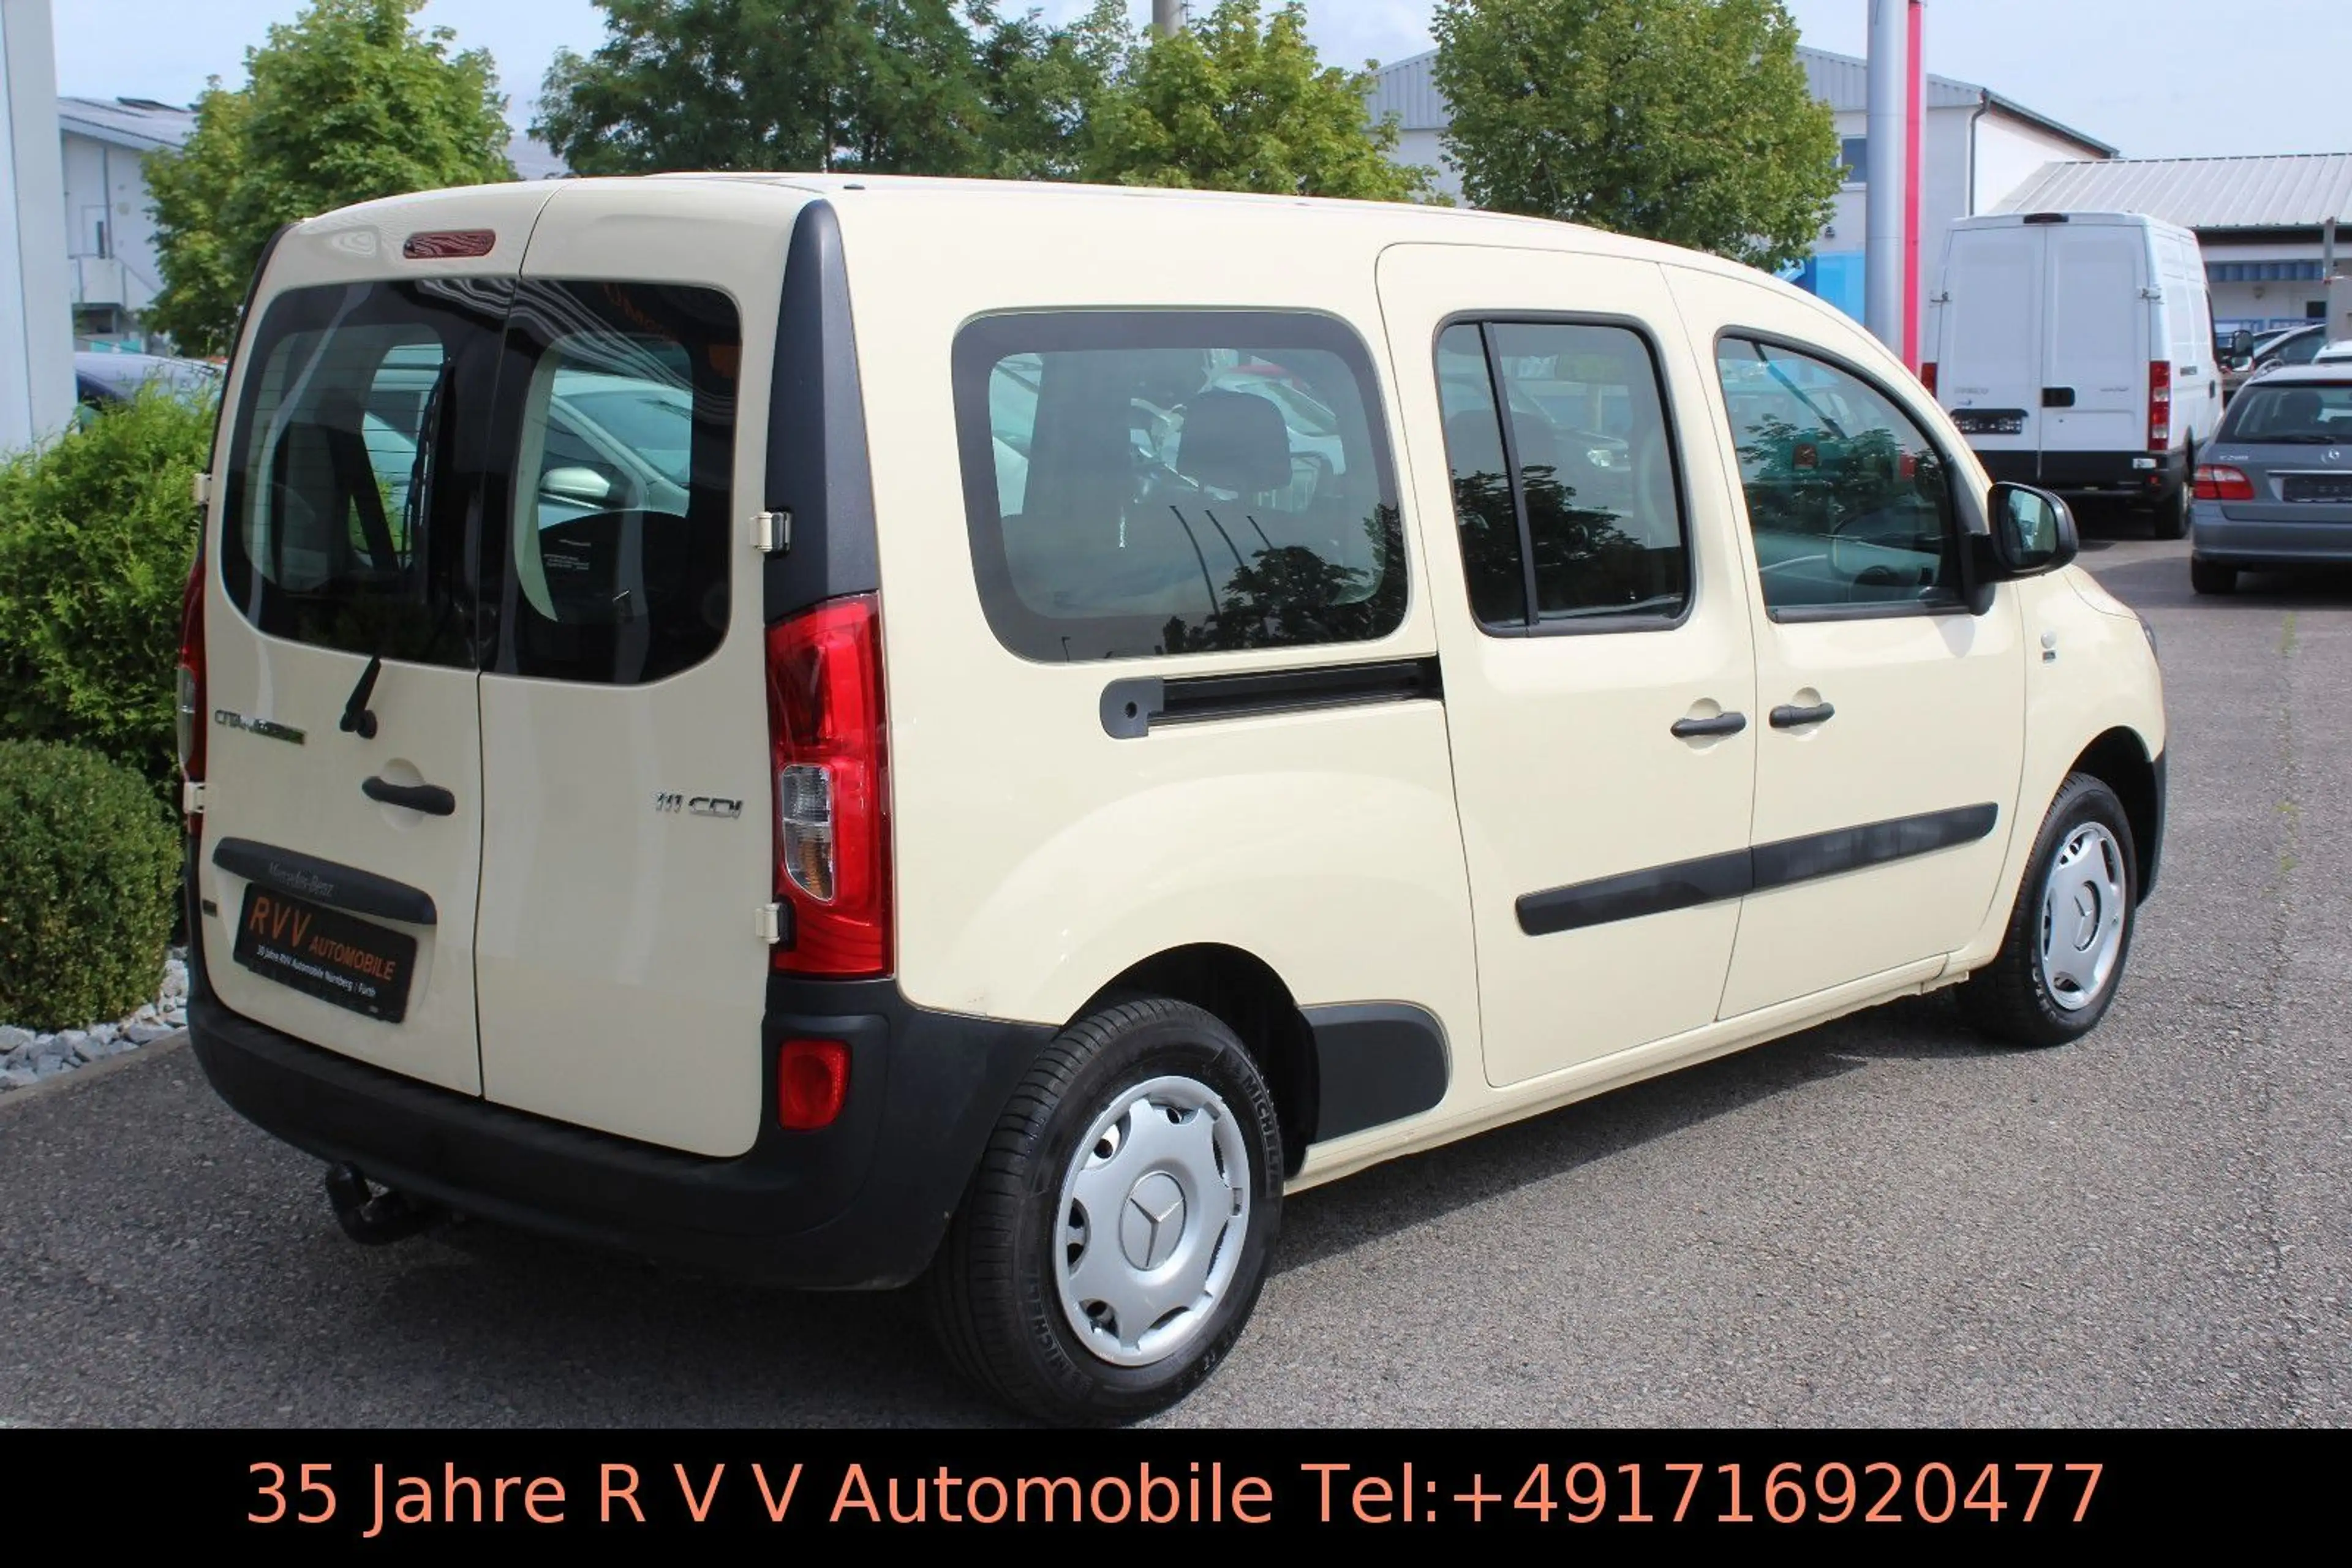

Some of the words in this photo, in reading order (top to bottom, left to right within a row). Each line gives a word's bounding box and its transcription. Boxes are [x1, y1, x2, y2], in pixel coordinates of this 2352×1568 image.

[688, 796, 744, 818] CDI
[309, 935, 396, 981] AUTOMOBILE
[1242, 1072, 1280, 1190] MICHELIN
